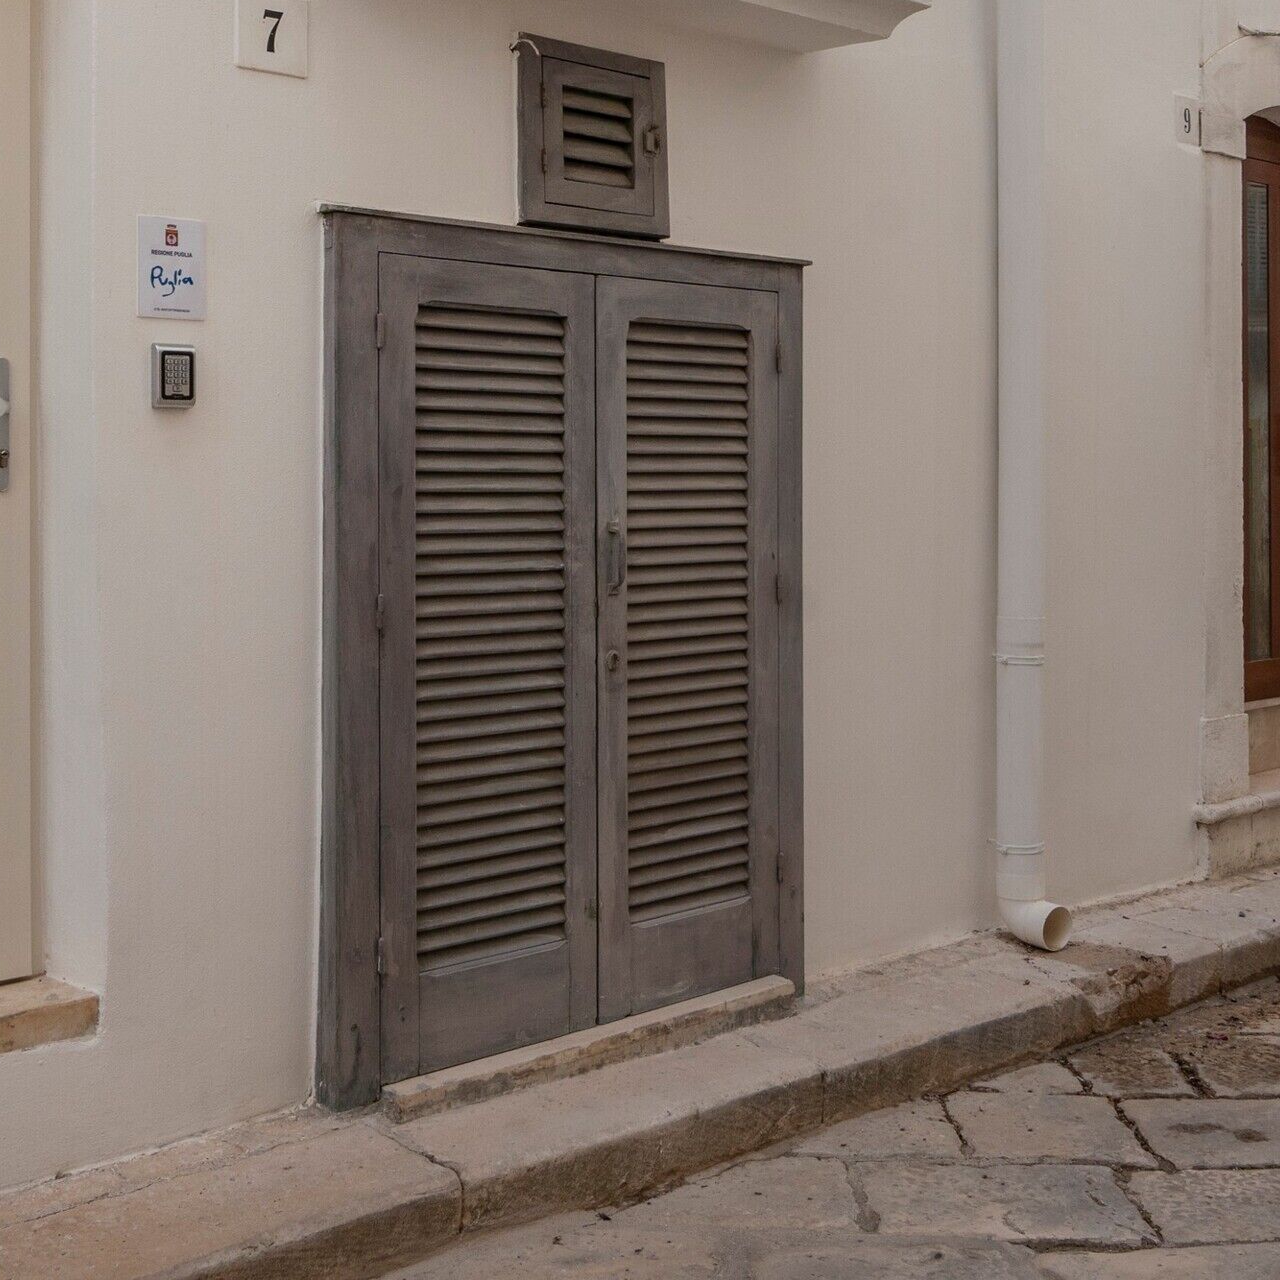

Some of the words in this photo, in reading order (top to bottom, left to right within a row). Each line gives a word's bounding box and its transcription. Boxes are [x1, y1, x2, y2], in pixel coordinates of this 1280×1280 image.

[263, 9, 284, 53] 7
[1184, 108, 1191, 133] 9
[151, 249, 173, 257] REGIONE
[173, 250, 193, 258] PUGLIA
[150, 265, 194, 298] Puglia
